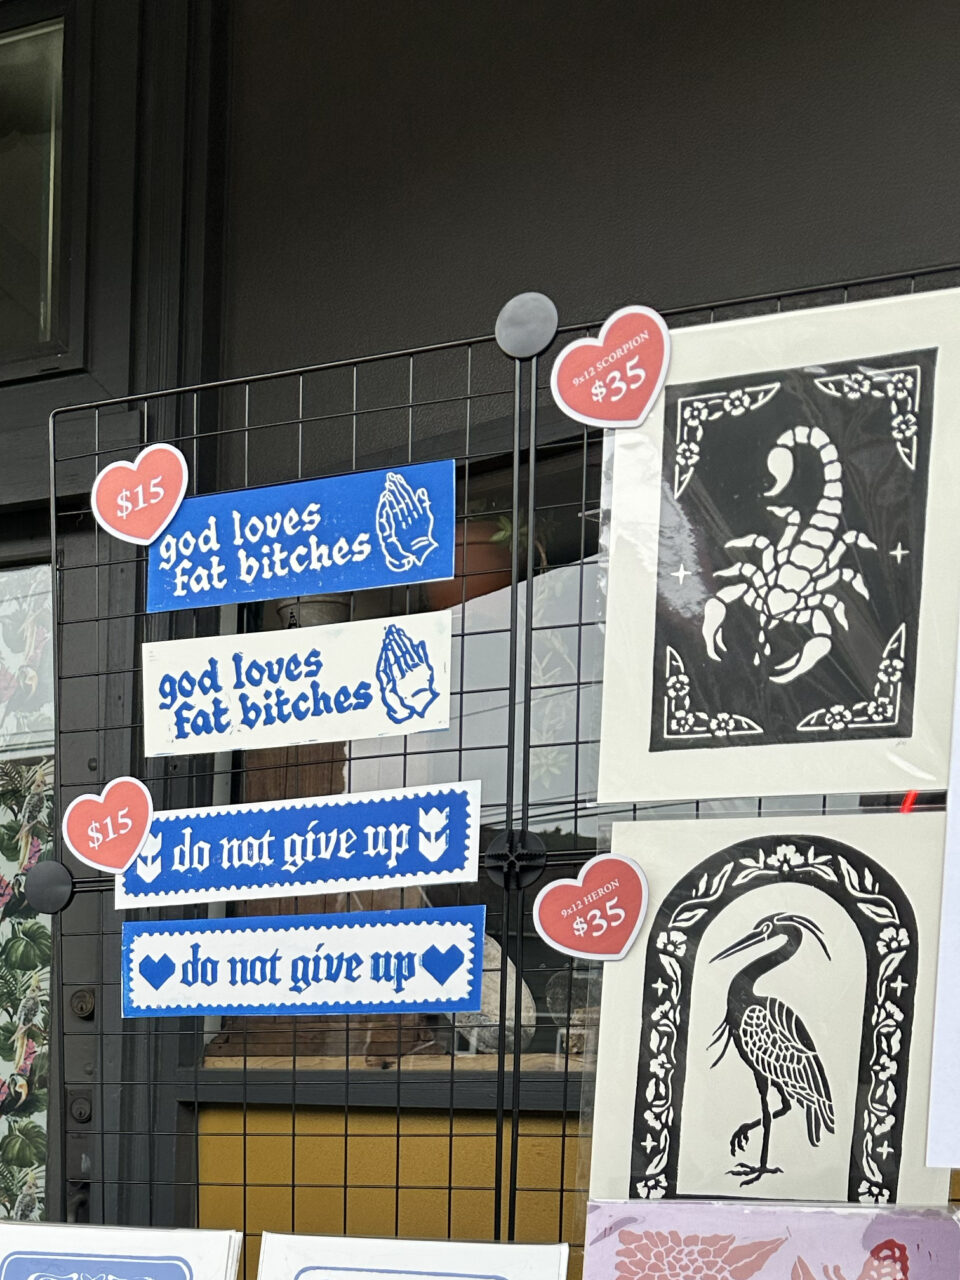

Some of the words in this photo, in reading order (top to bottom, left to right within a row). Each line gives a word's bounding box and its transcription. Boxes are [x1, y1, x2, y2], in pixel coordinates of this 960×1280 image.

[572, 366, 596, 387] 9x12
[596, 330, 650, 372] SCORPION
[591, 354, 646, 403] $35
[116, 476, 165, 519] $15
[158, 515, 221, 570] god
[232, 503, 321, 546] loves
[173, 556, 227, 597] fat
[239, 531, 372, 584] bitches
[158, 657, 222, 710] god
[232, 648, 323, 690] loves
[174, 697, 231, 739] fat
[240, 680, 373, 729] bitches
[87, 807, 133, 850] $15
[171, 827, 212, 873] do
[219, 829, 275, 869] not
[281, 819, 357, 874] give
[363, 823, 411, 868] up
[561, 902, 584, 918] 9x12
[584, 878, 620, 905] HERON
[572, 896, 626, 937] $35
[180, 943, 220, 987] do
[227, 948, 282, 987] not
[289, 943, 364, 994] give
[370, 950, 417, 994] up
